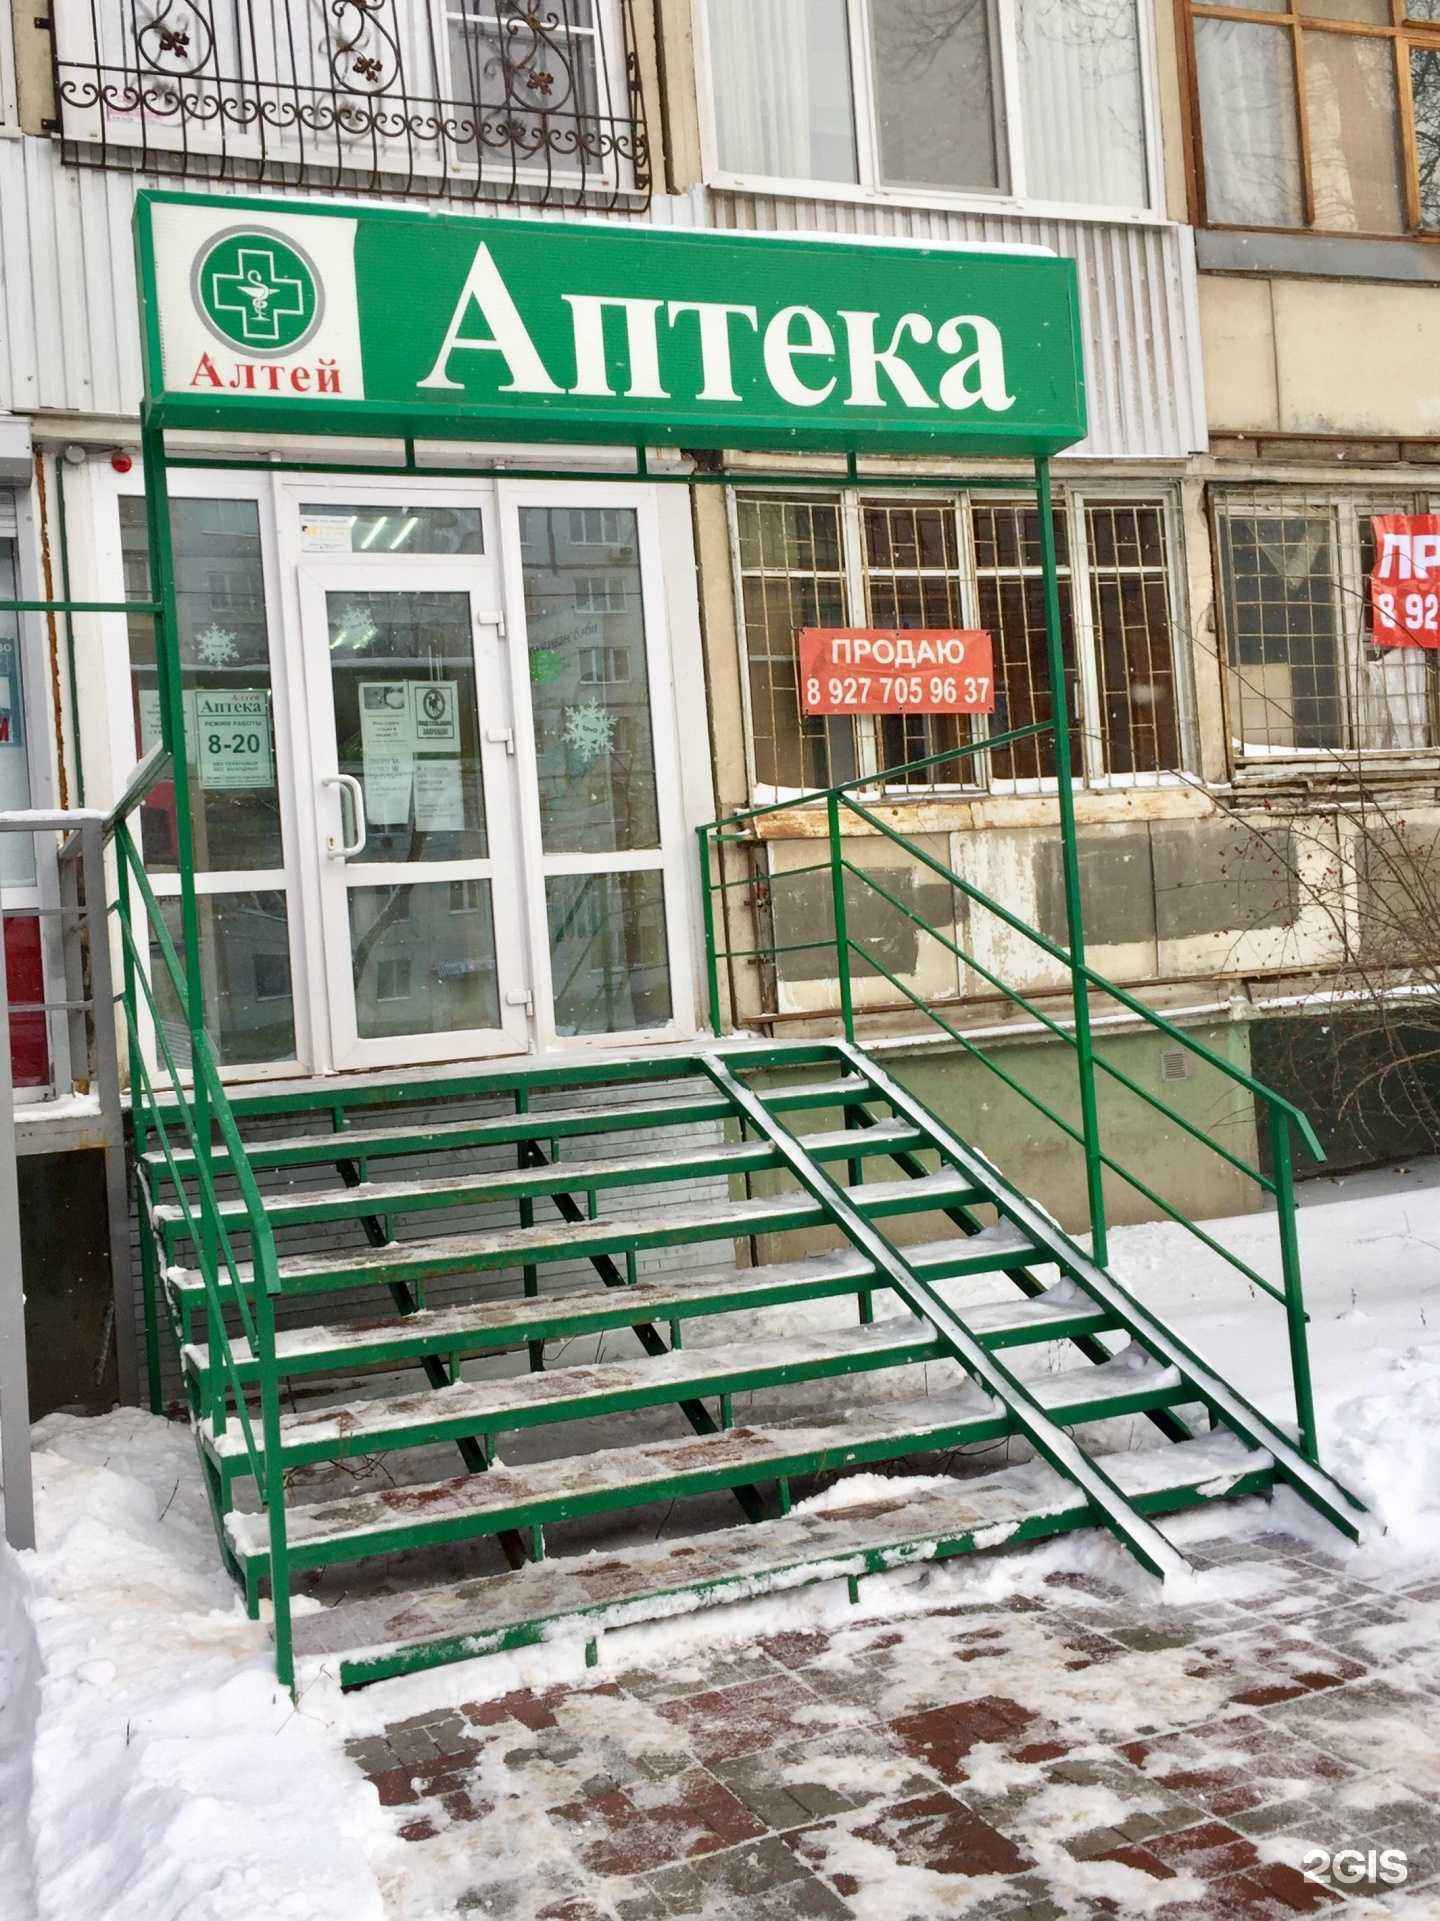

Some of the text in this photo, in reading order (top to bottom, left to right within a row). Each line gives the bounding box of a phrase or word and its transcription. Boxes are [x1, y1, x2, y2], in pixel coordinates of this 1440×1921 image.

[416, 241, 1016, 411] Аптека
[190, 352, 342, 393] Алтей
[1379, 593, 1438, 630] 8 92
[832, 639, 965, 668] ПРОДАЮ
[807, 677, 989, 704] 8 927 705 96 37
[201, 700, 262, 713] Аптека
[208, 734, 260, 754] 8-20
